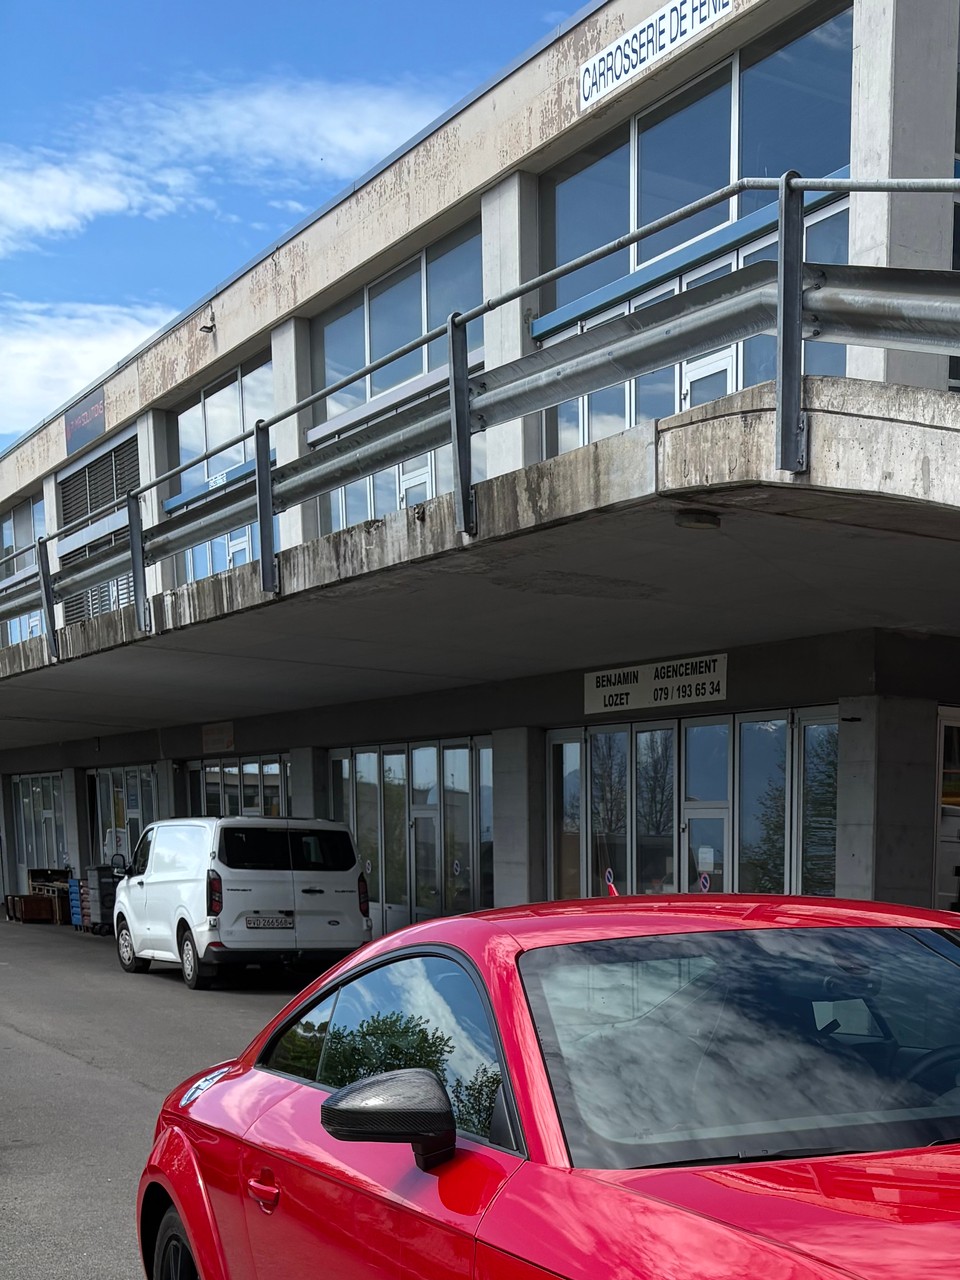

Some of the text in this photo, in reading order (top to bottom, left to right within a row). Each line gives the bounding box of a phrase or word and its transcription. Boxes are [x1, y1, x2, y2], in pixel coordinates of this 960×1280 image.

[583, 0, 730, 101] CARROSSERIE DE FEN
[595, 659, 718, 689] BENJAMIN AGENCEMENT
[603, 692, 630, 708] LOZET
[653, 686, 669, 702] 079
[676, 683, 692, 699] 193
[695, 682, 707, 697] 65
[709, 680, 721, 695] 34
